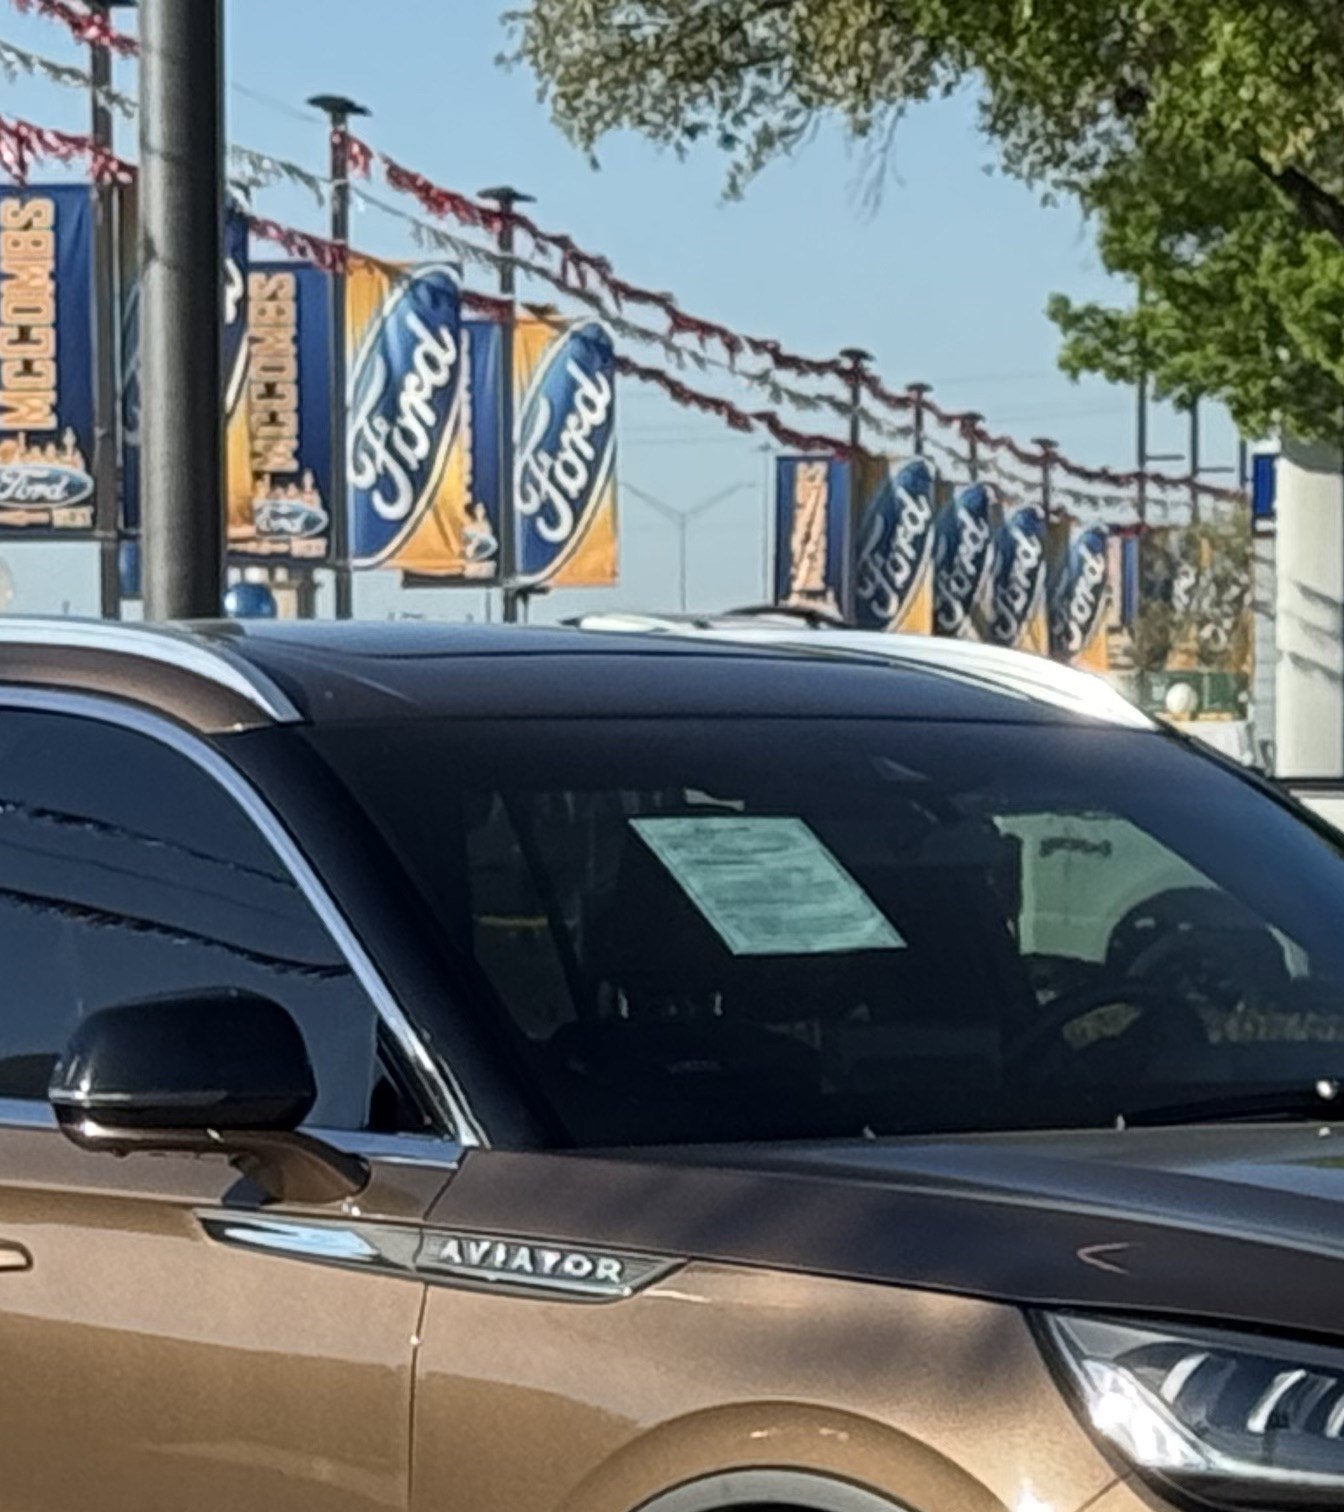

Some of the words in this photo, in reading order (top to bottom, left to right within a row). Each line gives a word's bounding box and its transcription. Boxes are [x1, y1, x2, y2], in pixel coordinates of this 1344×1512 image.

[347, 312, 457, 521] Ford
[514, 358, 611, 543] Ford
[858, 486, 932, 620] Ford
[936, 507, 990, 632] Ford
[994, 527, 1043, 641] Ford
[440, 1239, 623, 1285] AVIATOR
